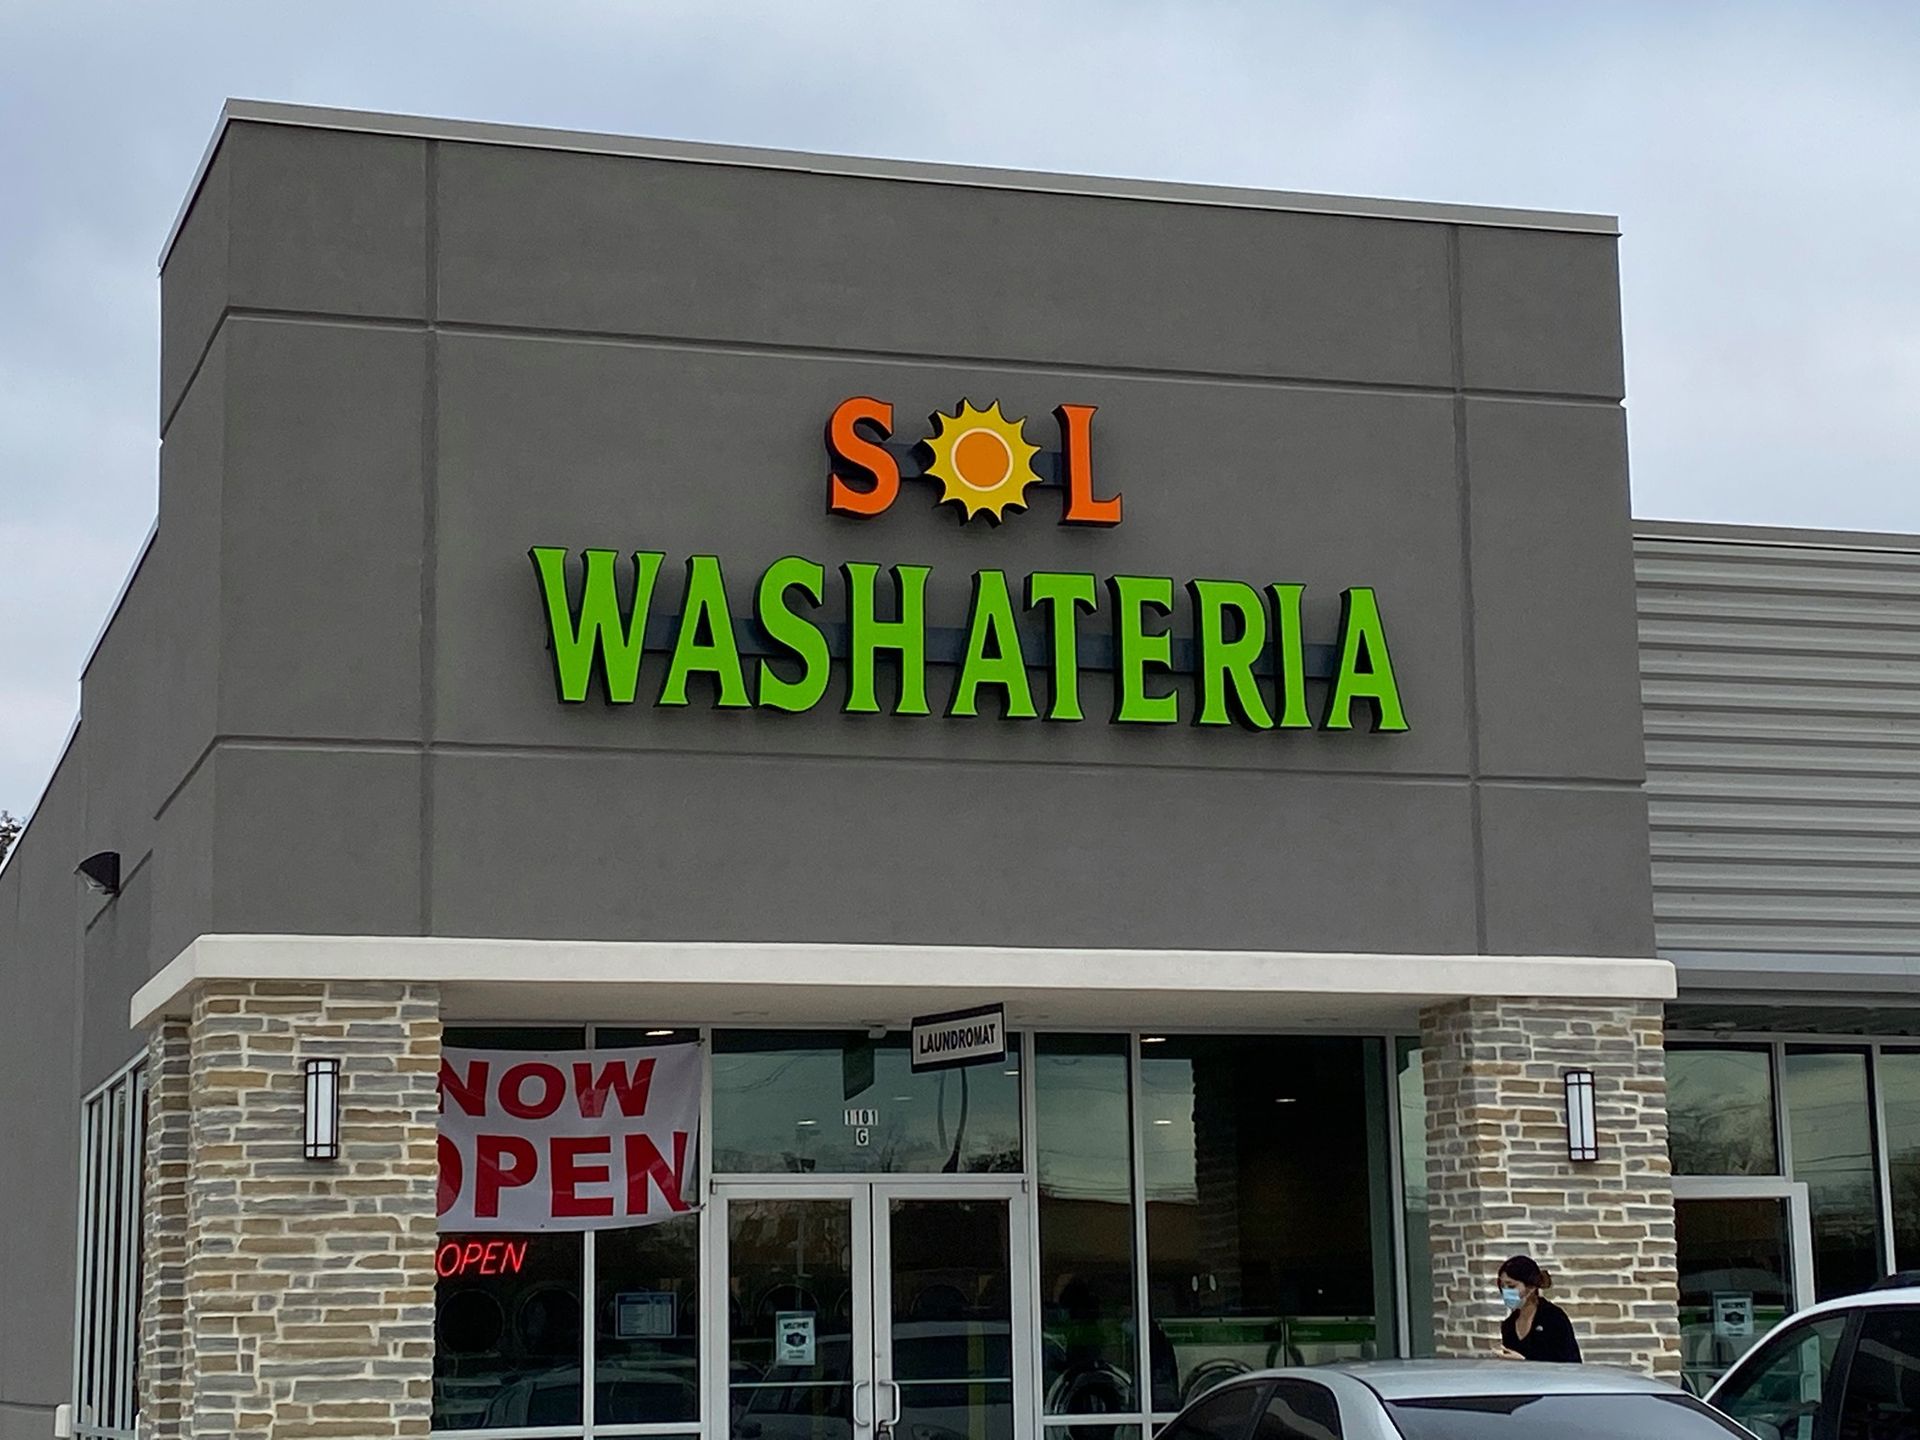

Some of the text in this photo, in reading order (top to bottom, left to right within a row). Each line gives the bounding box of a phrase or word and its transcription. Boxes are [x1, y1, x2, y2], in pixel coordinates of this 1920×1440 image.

[529, 546, 1411, 733] WASHATERIA
[920, 1023, 996, 1055] LAUNDROMAT
[438, 1057, 656, 1119] NOW
[858, 1129, 867, 1144] G
[436, 1242, 528, 1277] OPEN
